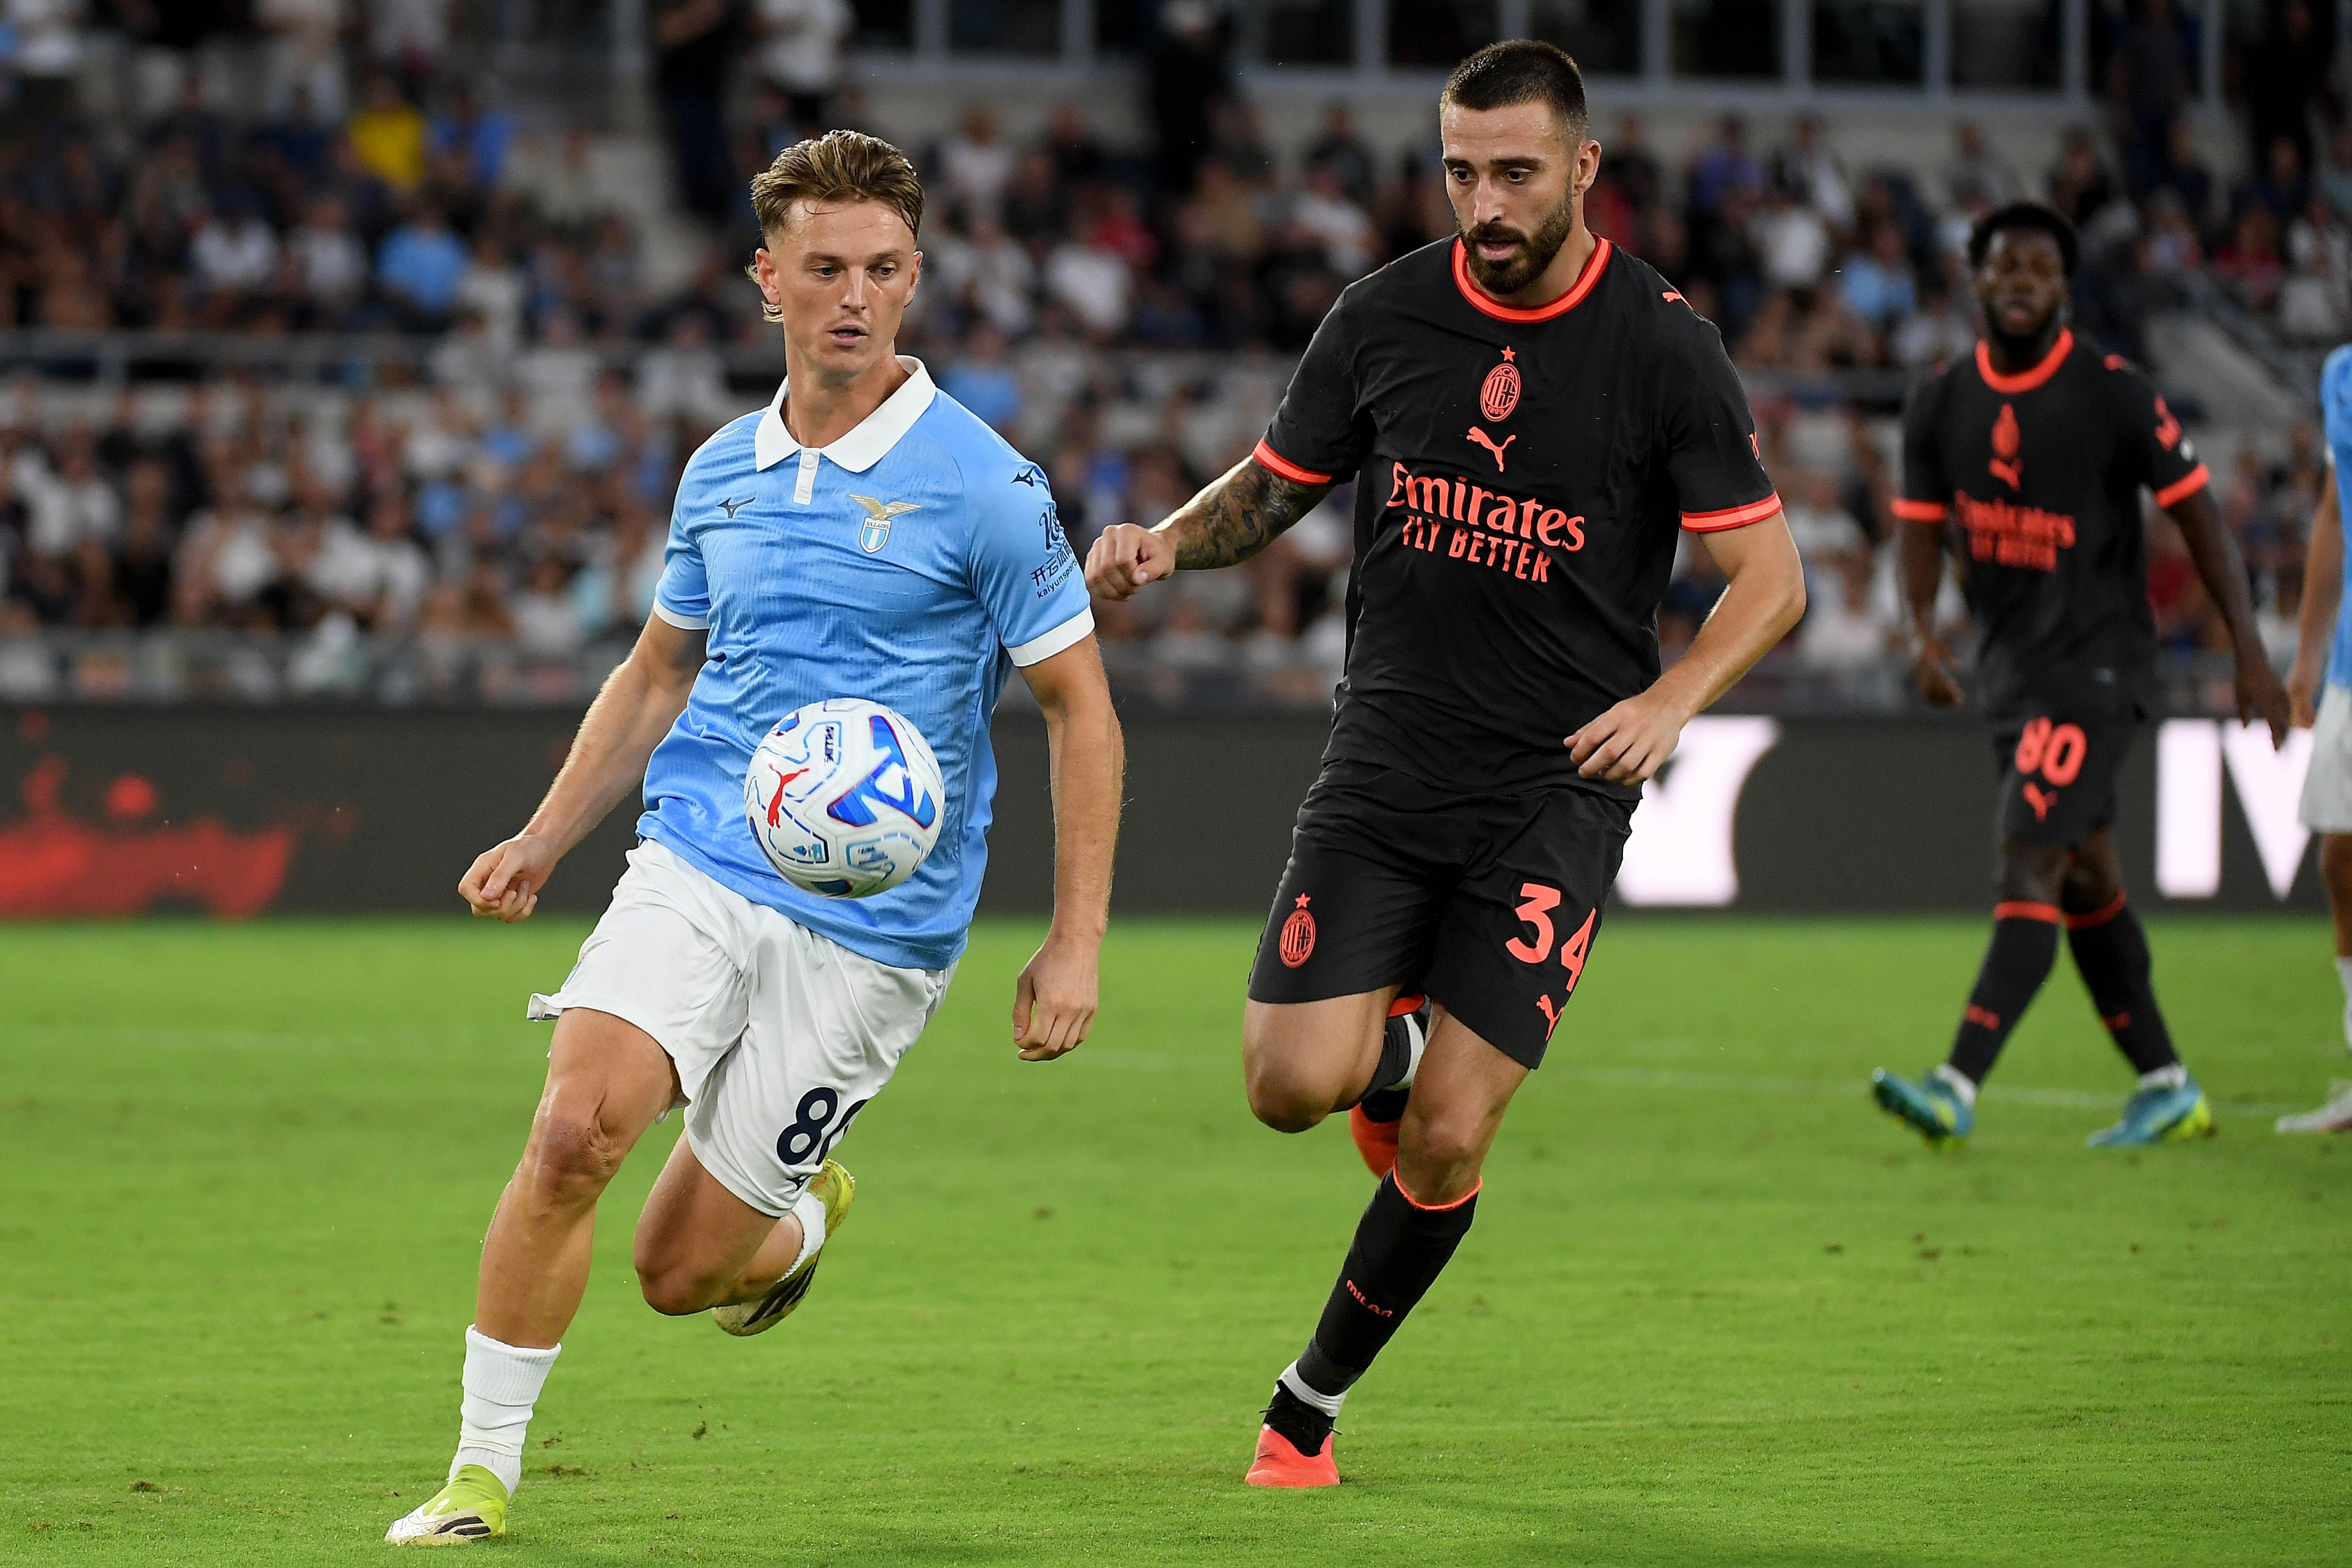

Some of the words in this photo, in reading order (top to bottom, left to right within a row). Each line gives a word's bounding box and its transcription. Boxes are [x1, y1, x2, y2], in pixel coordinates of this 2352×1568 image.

[1496, 369, 1514, 381] ACM
[1488, 406, 1504, 414] 1899
[1387, 462, 1585, 552] Emirates
[1403, 516, 1441, 552] FLY
[1449, 527, 1551, 583] BETTER
[2016, 718, 2086, 787] 80
[1506, 883, 1596, 997] 34
